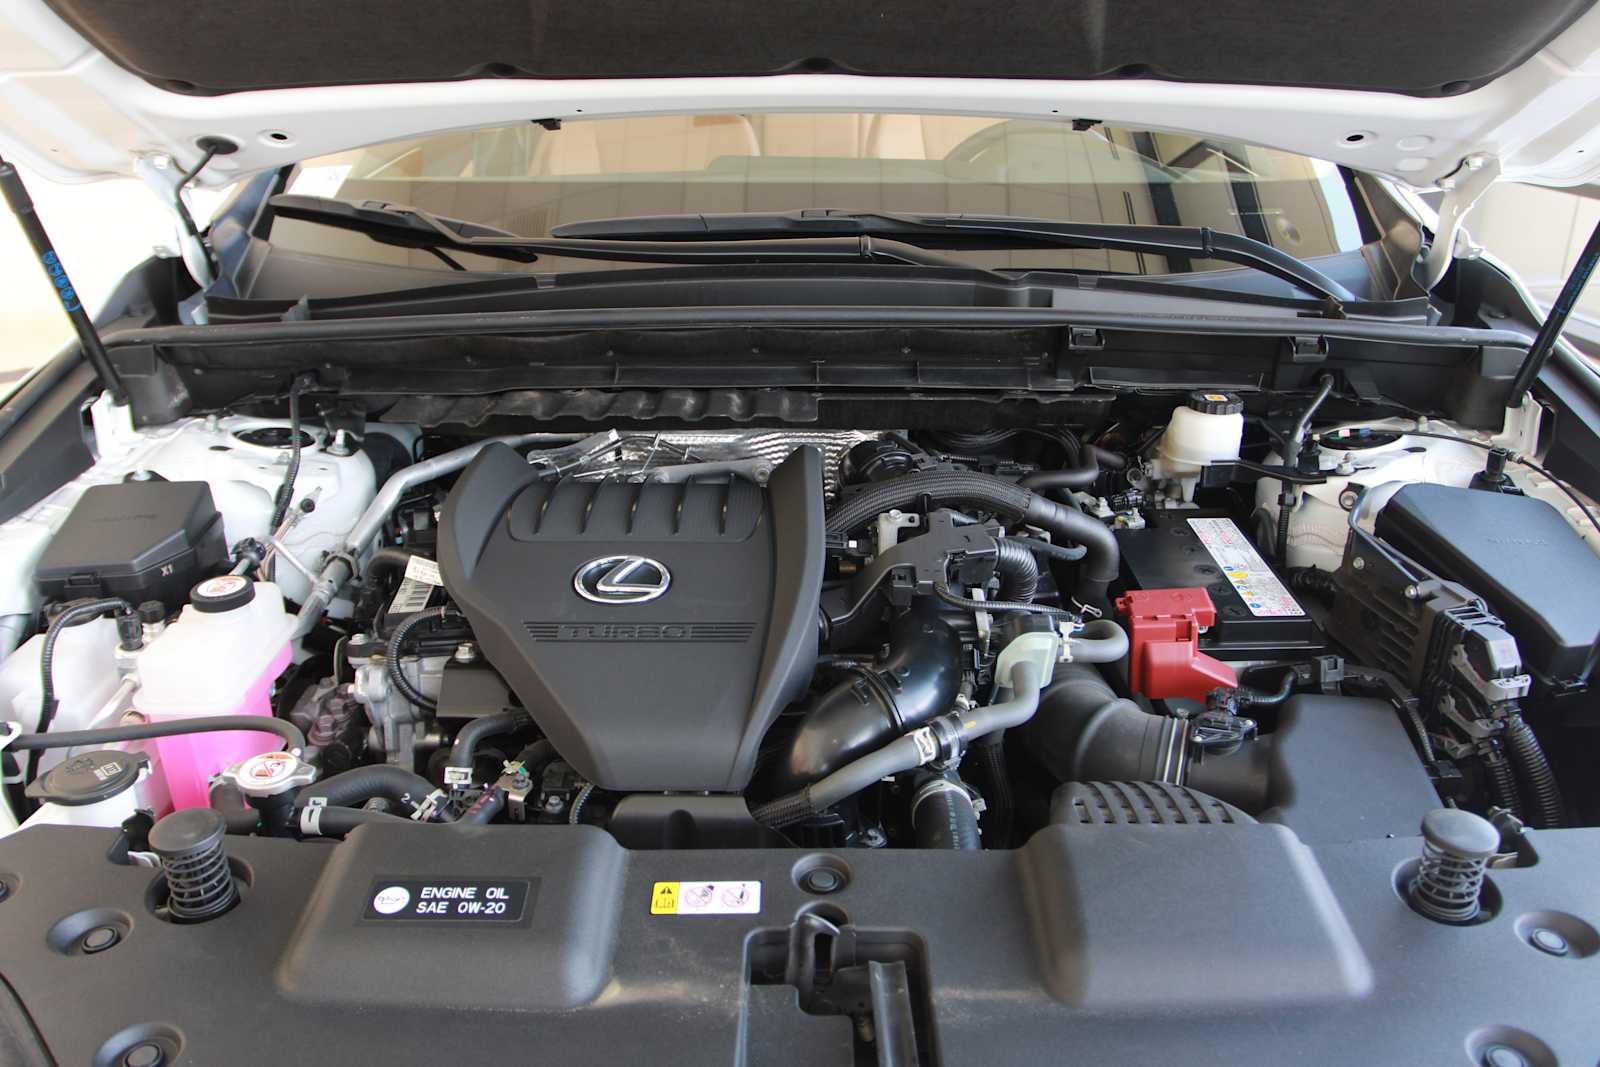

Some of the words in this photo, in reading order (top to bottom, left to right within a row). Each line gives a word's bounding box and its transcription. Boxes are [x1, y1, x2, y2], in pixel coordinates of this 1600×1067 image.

[561, 624, 687, 640] TURBO
[420, 886, 477, 899] ENGINE
[485, 886, 509, 899] OIL
[415, 901, 449, 914] SAE
[457, 901, 506, 914] 0W-20
